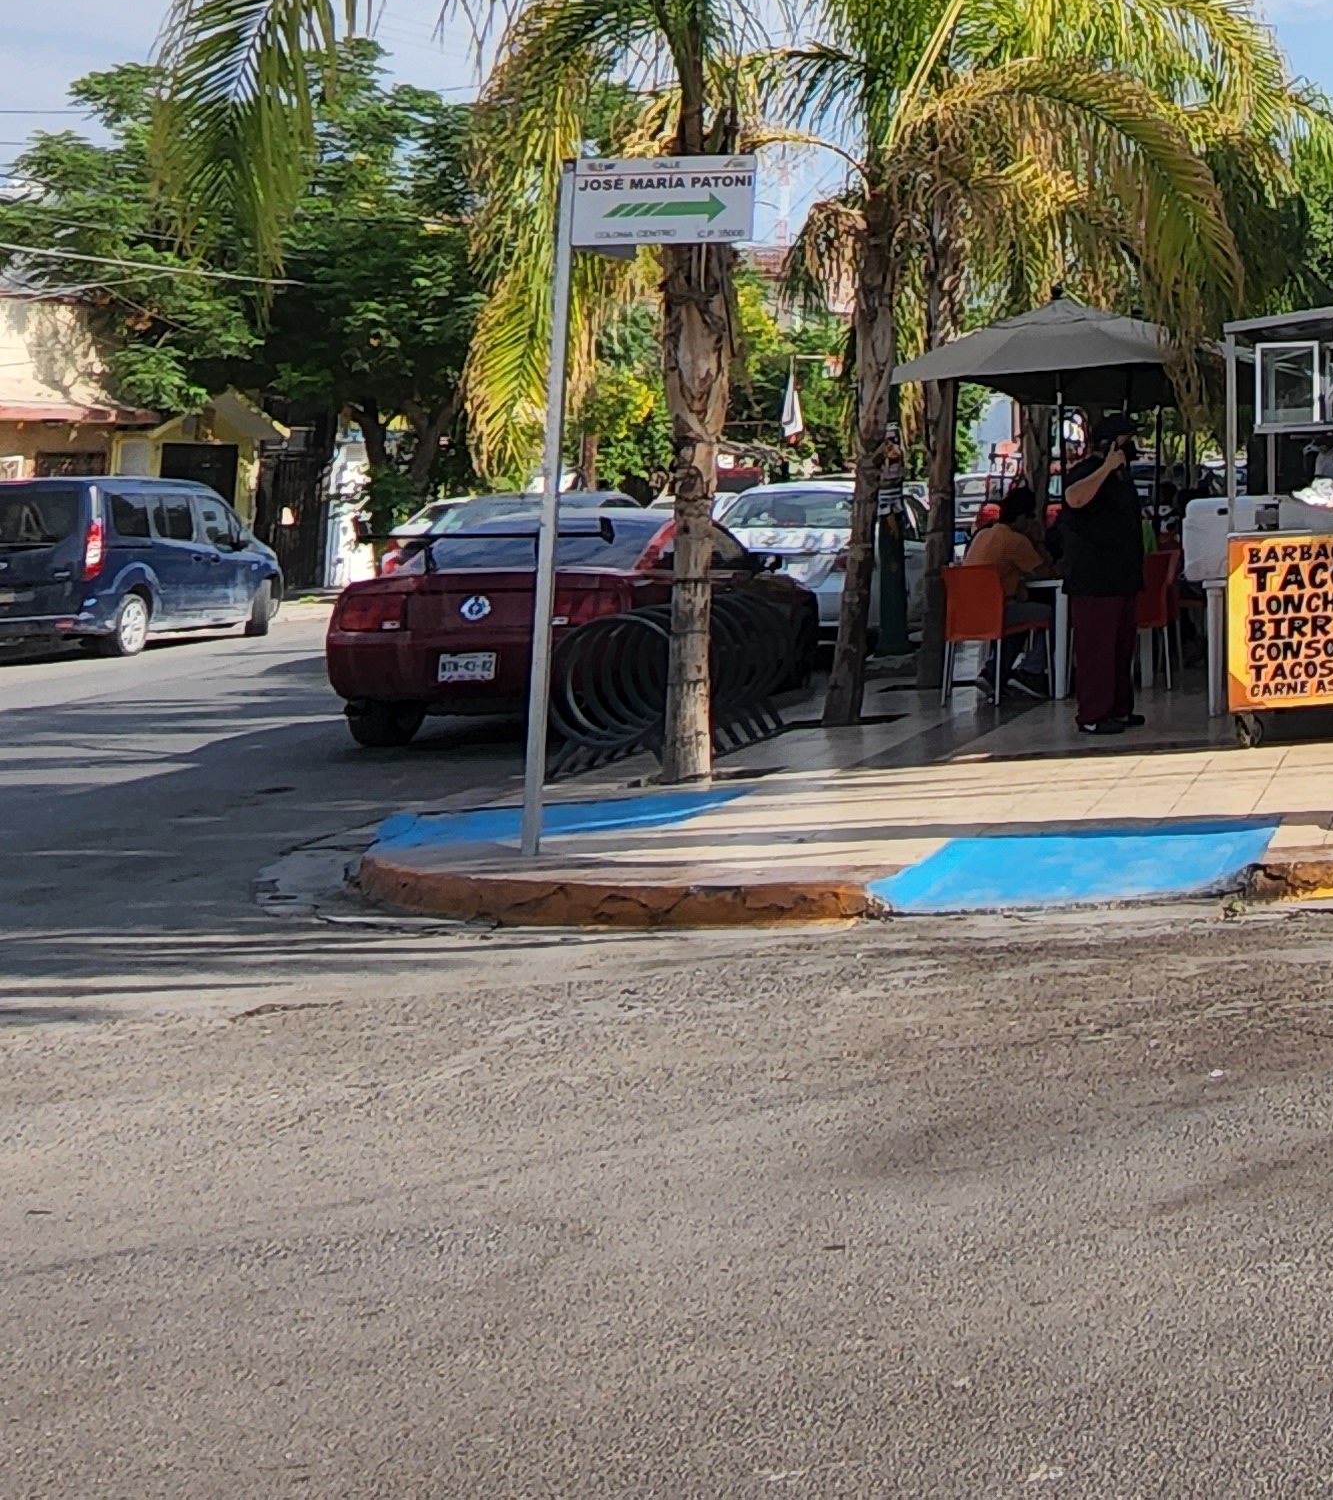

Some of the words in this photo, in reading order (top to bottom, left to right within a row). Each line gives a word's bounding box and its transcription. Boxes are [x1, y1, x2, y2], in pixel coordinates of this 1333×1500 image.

[653, 161, 681, 169] CALLE
[578, 174, 624, 191] JOSÉ
[629, 173, 686, 190] MARÍA
[690, 174, 753, 189] PATONI
[595, 230, 633, 239] COLONIA
[636, 228, 677, 238] CENTRO
[1249, 660, 1333, 682] TACOS
[1251, 680, 1309, 698] CARNE
